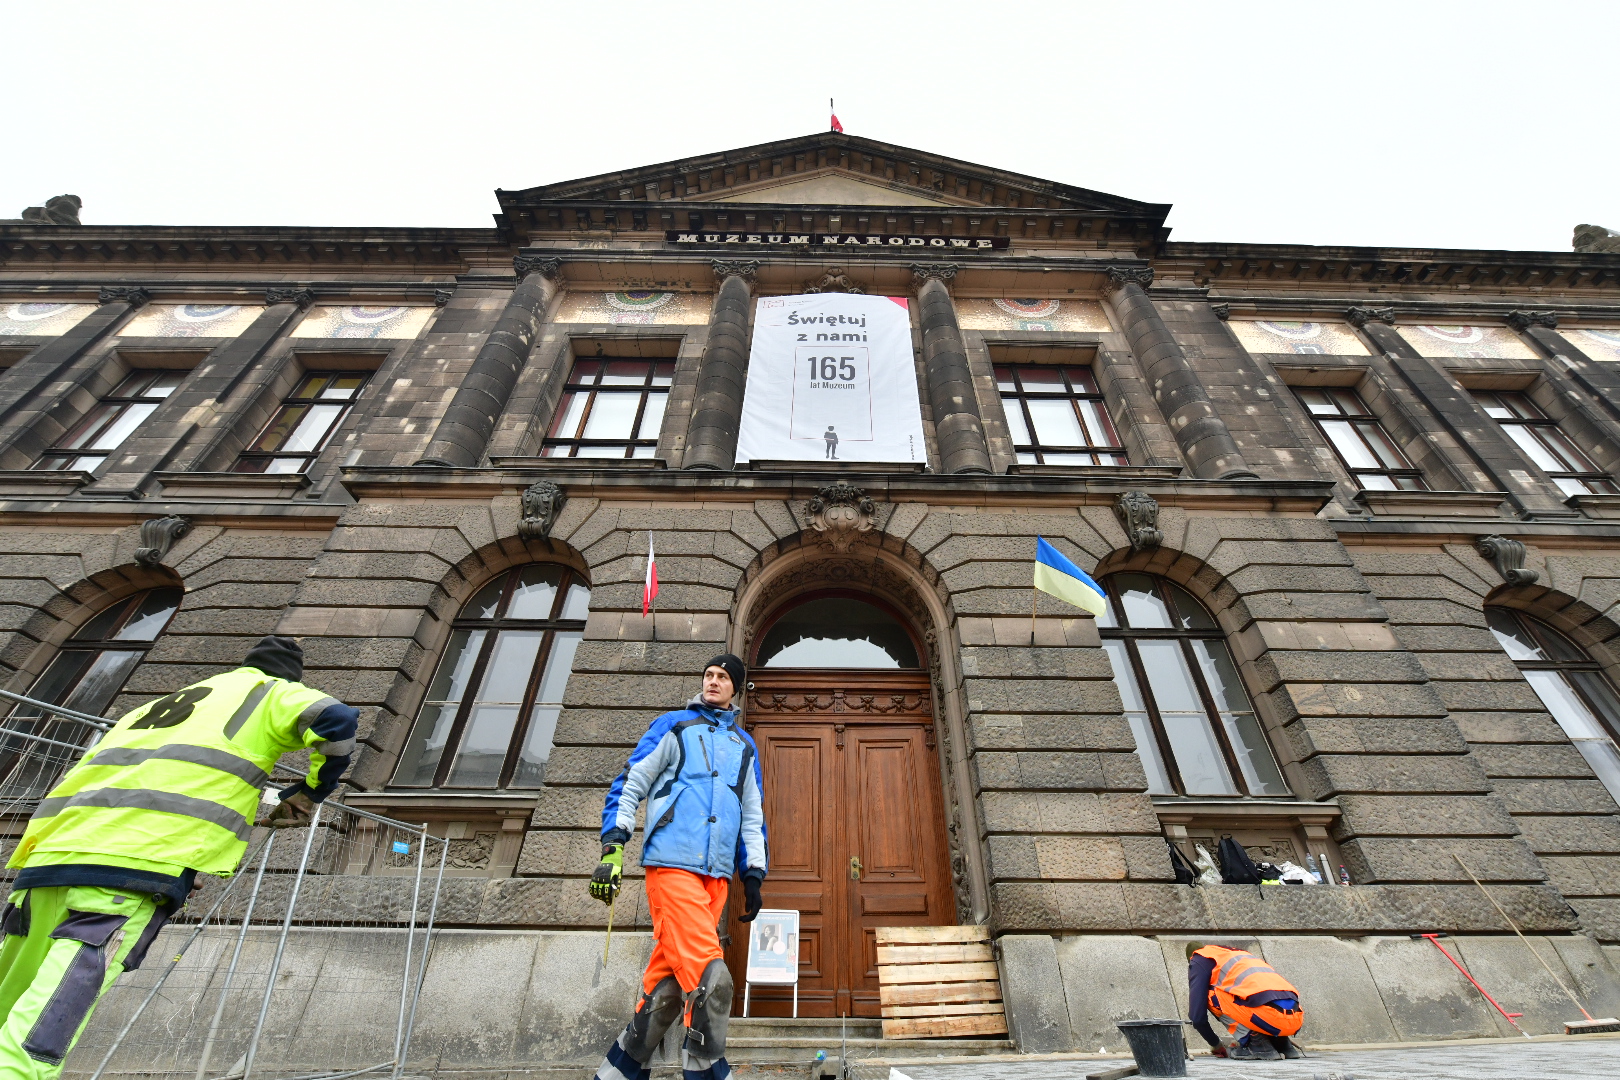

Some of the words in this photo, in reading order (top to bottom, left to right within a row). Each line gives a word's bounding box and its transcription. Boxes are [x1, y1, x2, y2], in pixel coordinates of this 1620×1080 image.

[676, 233, 810, 244] MUZEUM
[822, 235, 993, 248] NARODOWE
[787, 310, 866, 328] Świętuj
[796, 333, 808, 342] z
[816, 330, 868, 342] nami
[807, 356, 856, 381] 165
[810, 381, 820, 389] lat
[822, 381, 855, 390] Muzeum
